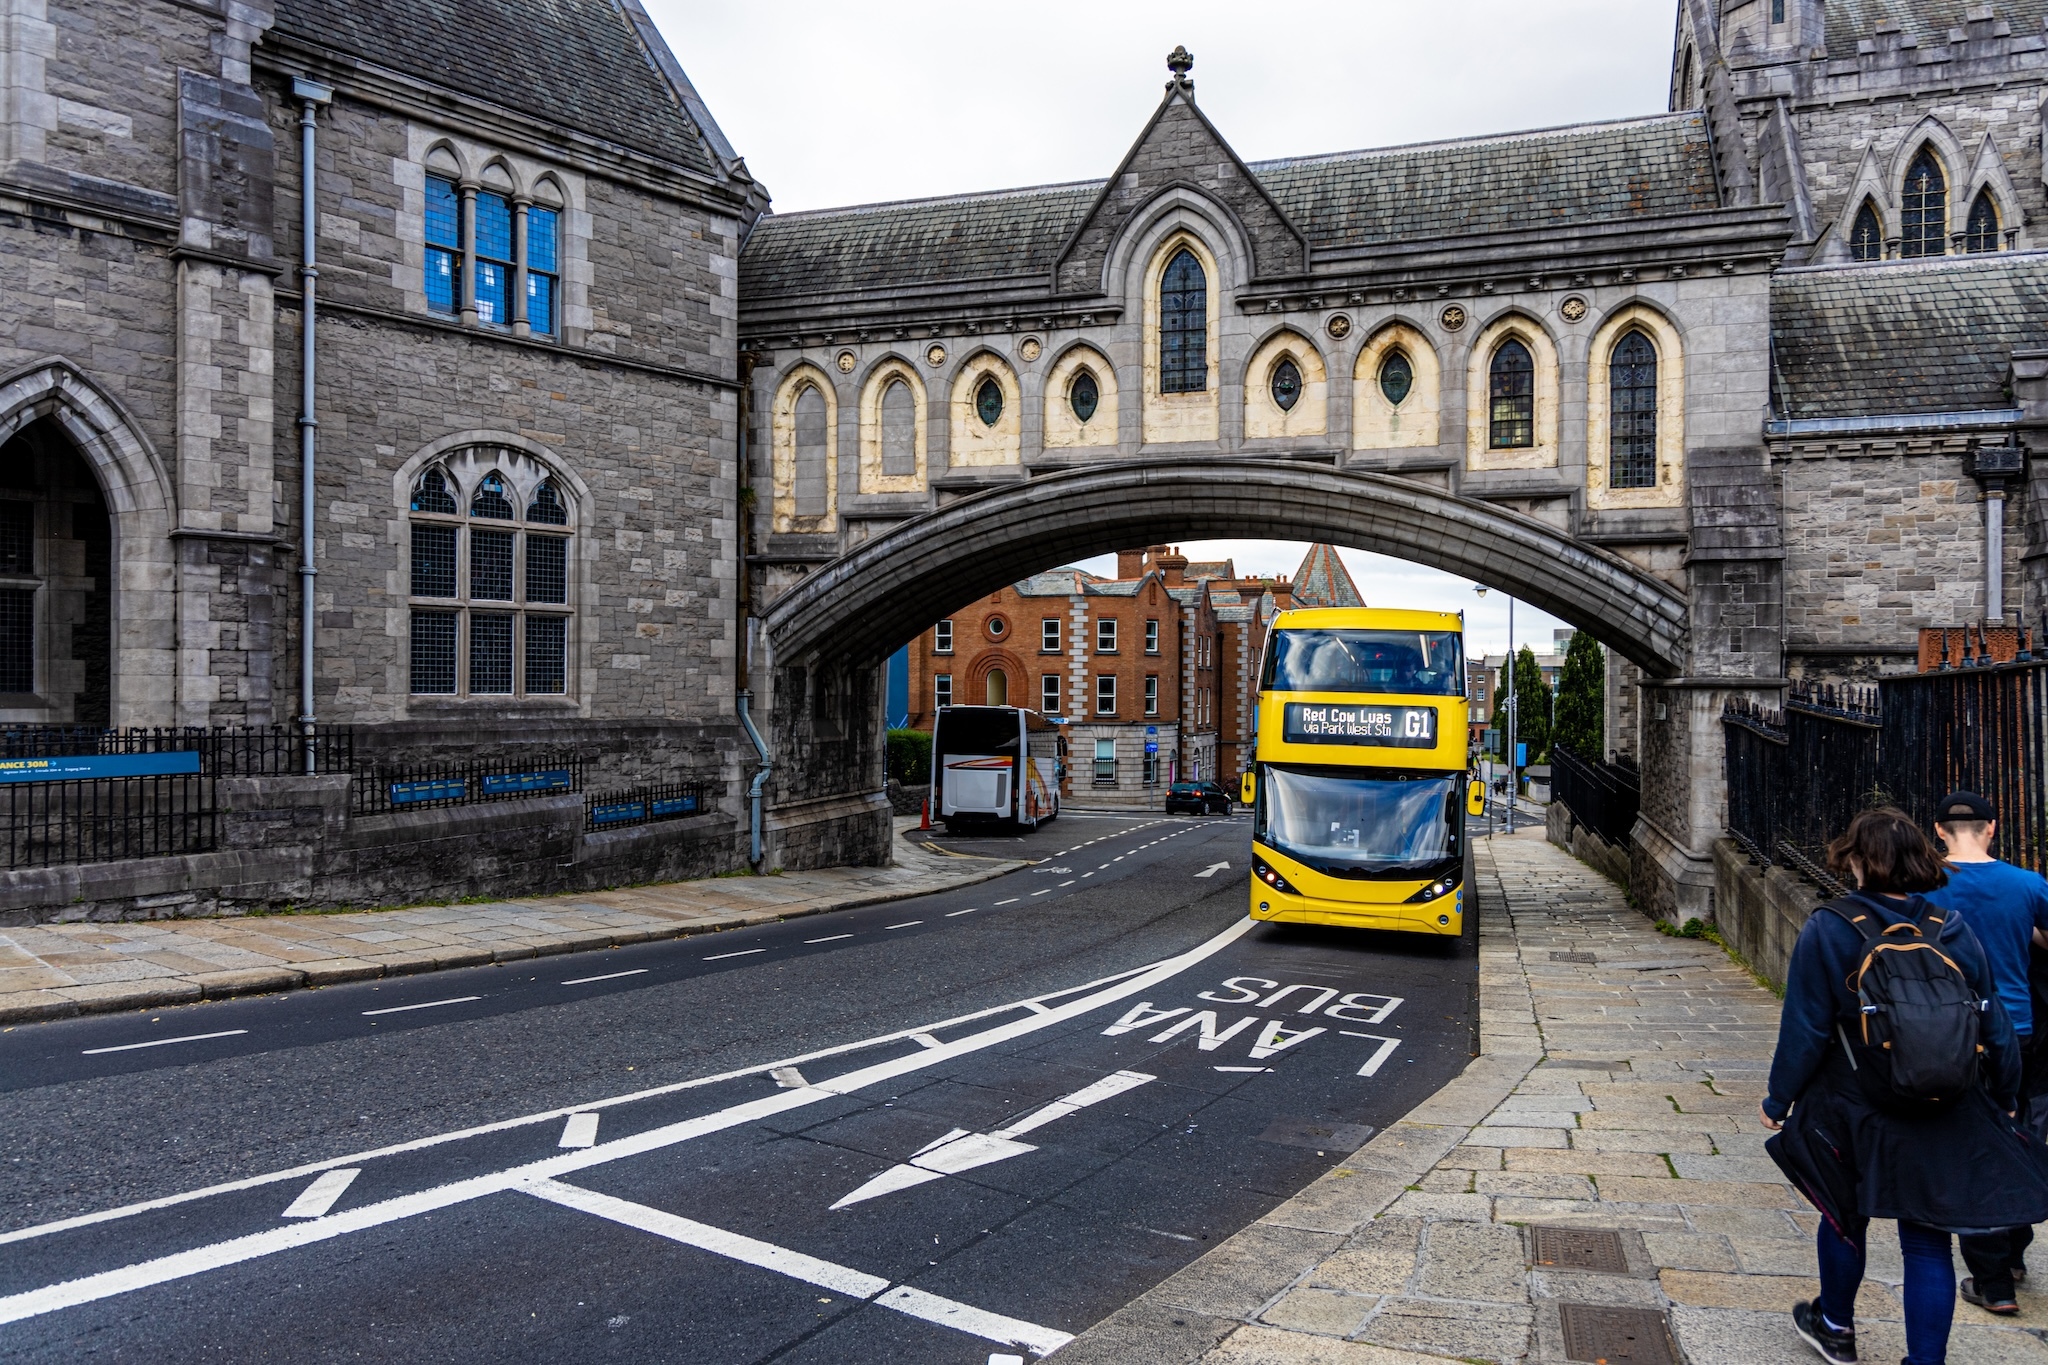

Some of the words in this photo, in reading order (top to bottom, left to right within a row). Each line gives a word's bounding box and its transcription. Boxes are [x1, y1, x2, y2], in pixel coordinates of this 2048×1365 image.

[1303, 708, 1326, 722] Red
[1331, 709, 1355, 723] Cow
[1360, 710, 1392, 725] Luas
[1405, 711, 1430, 738] G1
[1303, 722, 1319, 734] via
[1321, 722, 1344, 735] Park
[1346, 723, 1372, 736] West
[1374, 724, 1391, 737] Stn
[26, 760, 48, 768] 30M
[1197, 976, 1405, 1024] BUS
